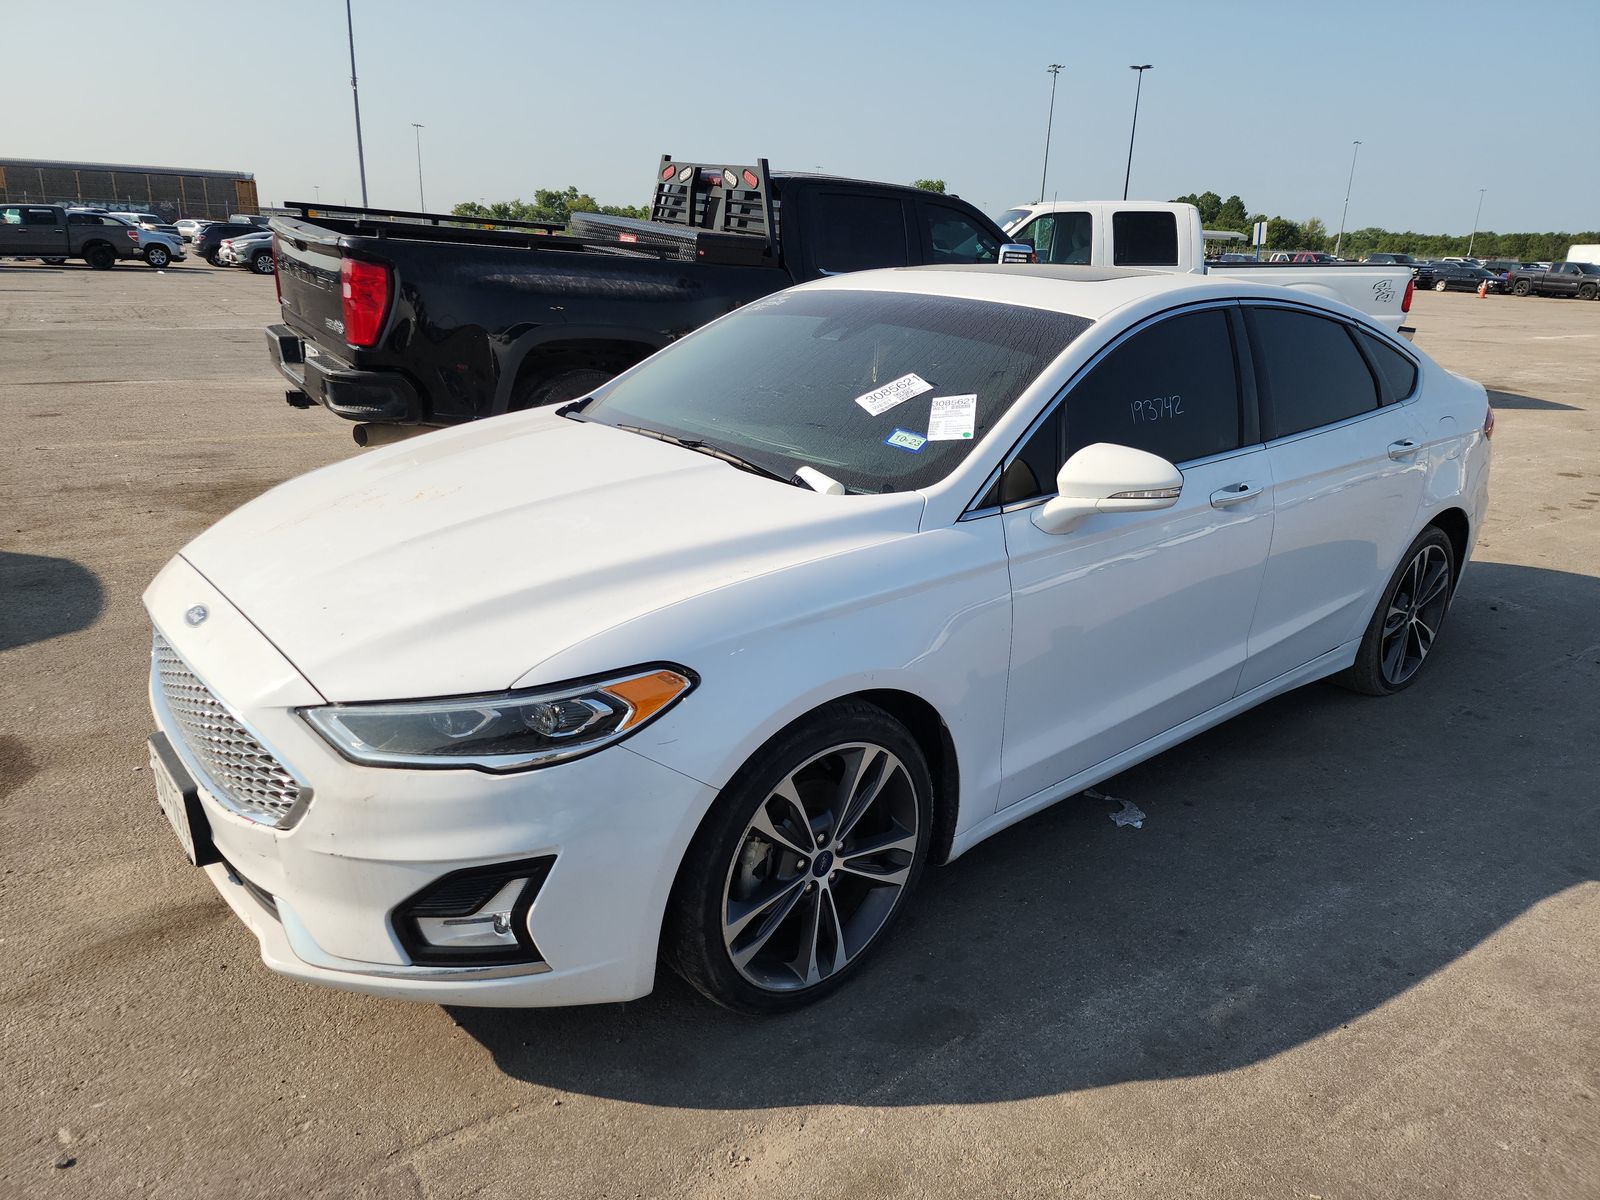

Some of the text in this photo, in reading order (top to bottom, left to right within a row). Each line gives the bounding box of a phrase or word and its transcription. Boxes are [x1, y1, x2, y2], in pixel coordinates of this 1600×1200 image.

[866, 375, 920, 403] 3085621
[932, 398, 975, 407] 3085621
[1130, 395, 1184, 425] 193742
